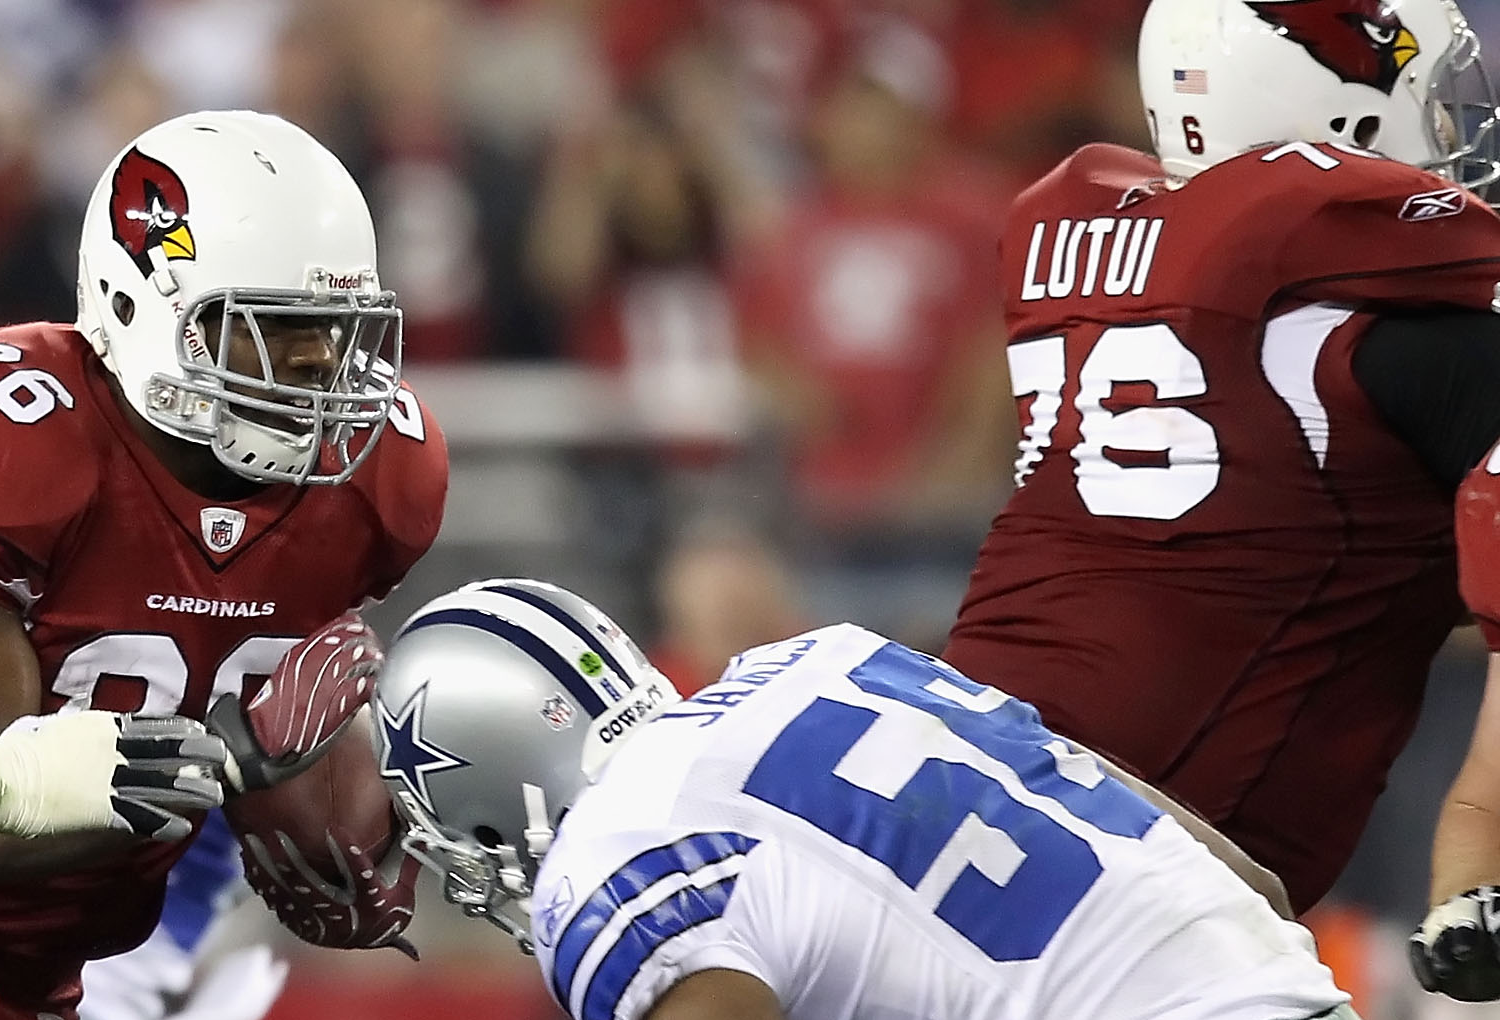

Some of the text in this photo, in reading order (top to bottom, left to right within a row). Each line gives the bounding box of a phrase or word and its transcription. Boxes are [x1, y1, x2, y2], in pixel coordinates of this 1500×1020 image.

[1020, 217, 1164, 301] LUTUI
[1006, 323, 1221, 521] 76
[146, 594, 276, 618] CARDINALS
